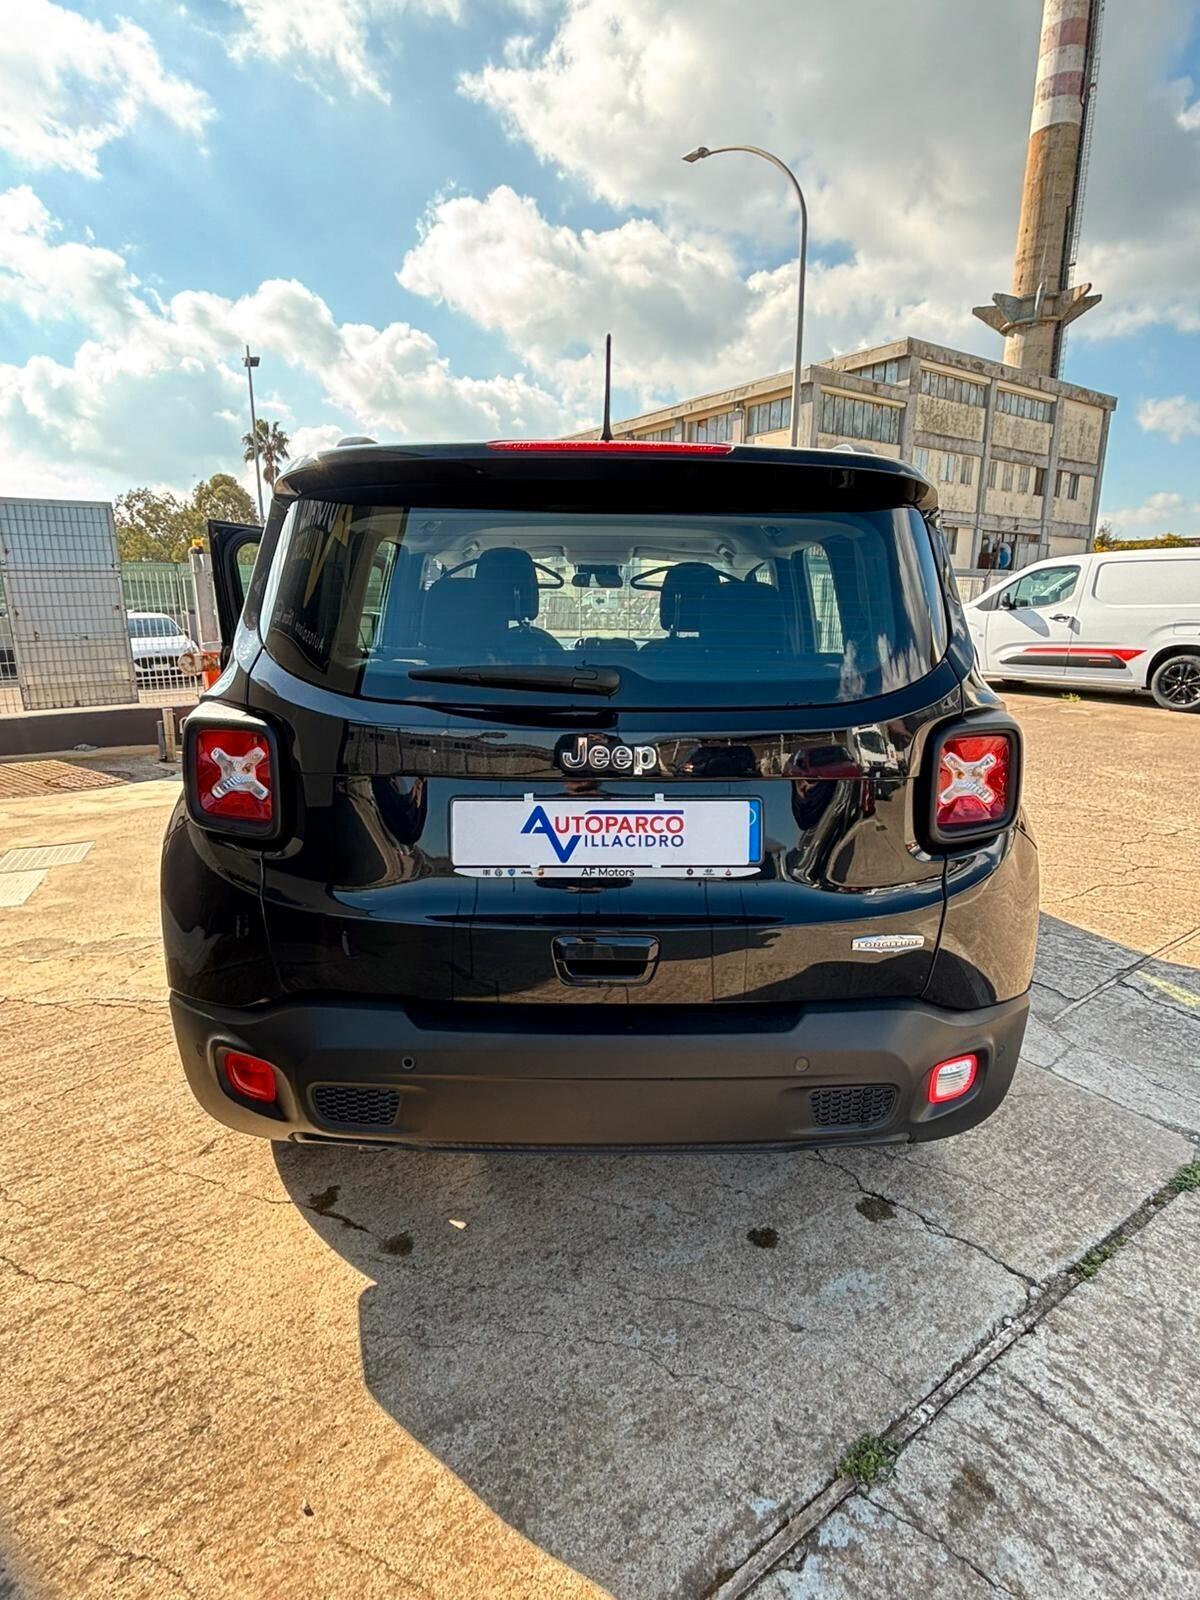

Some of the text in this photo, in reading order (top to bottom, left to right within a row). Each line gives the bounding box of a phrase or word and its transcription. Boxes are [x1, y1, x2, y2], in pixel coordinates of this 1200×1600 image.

[562, 737, 659, 775] Jeep
[520, 805, 684, 834] AUTOPARCO
[546, 833, 684, 863] VILLACIDRO
[581, 867, 635, 876] AF Motors
[857, 940, 919, 949] LONGITUDE
